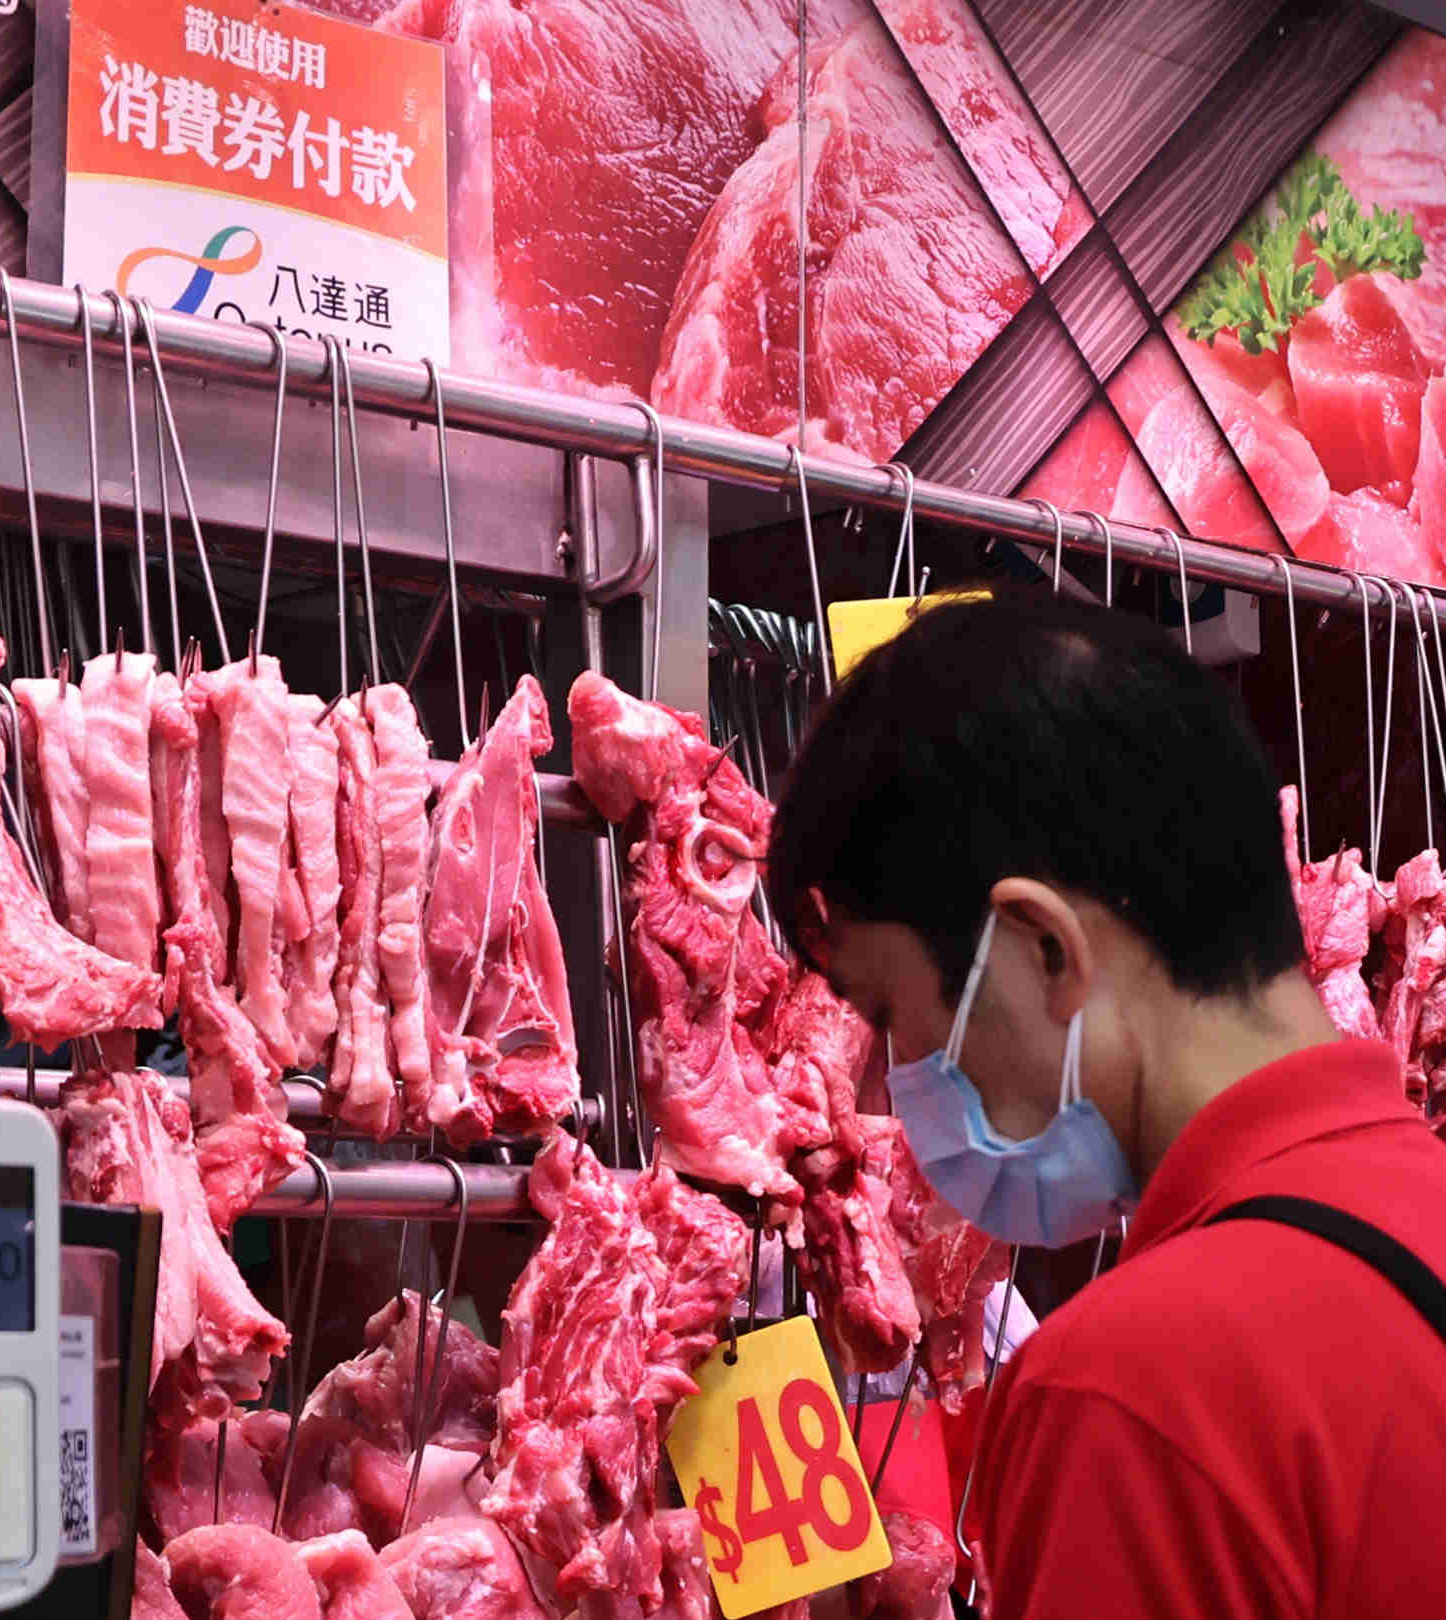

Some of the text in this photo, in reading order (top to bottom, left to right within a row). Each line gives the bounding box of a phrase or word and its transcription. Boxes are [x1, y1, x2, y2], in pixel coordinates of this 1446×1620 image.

[184, 4, 327, 90] 歡迎使用
[98, 54, 418, 214] 消費券付款
[268, 263, 394, 332] 八達通
[694, 1377, 872, 1584] $48
